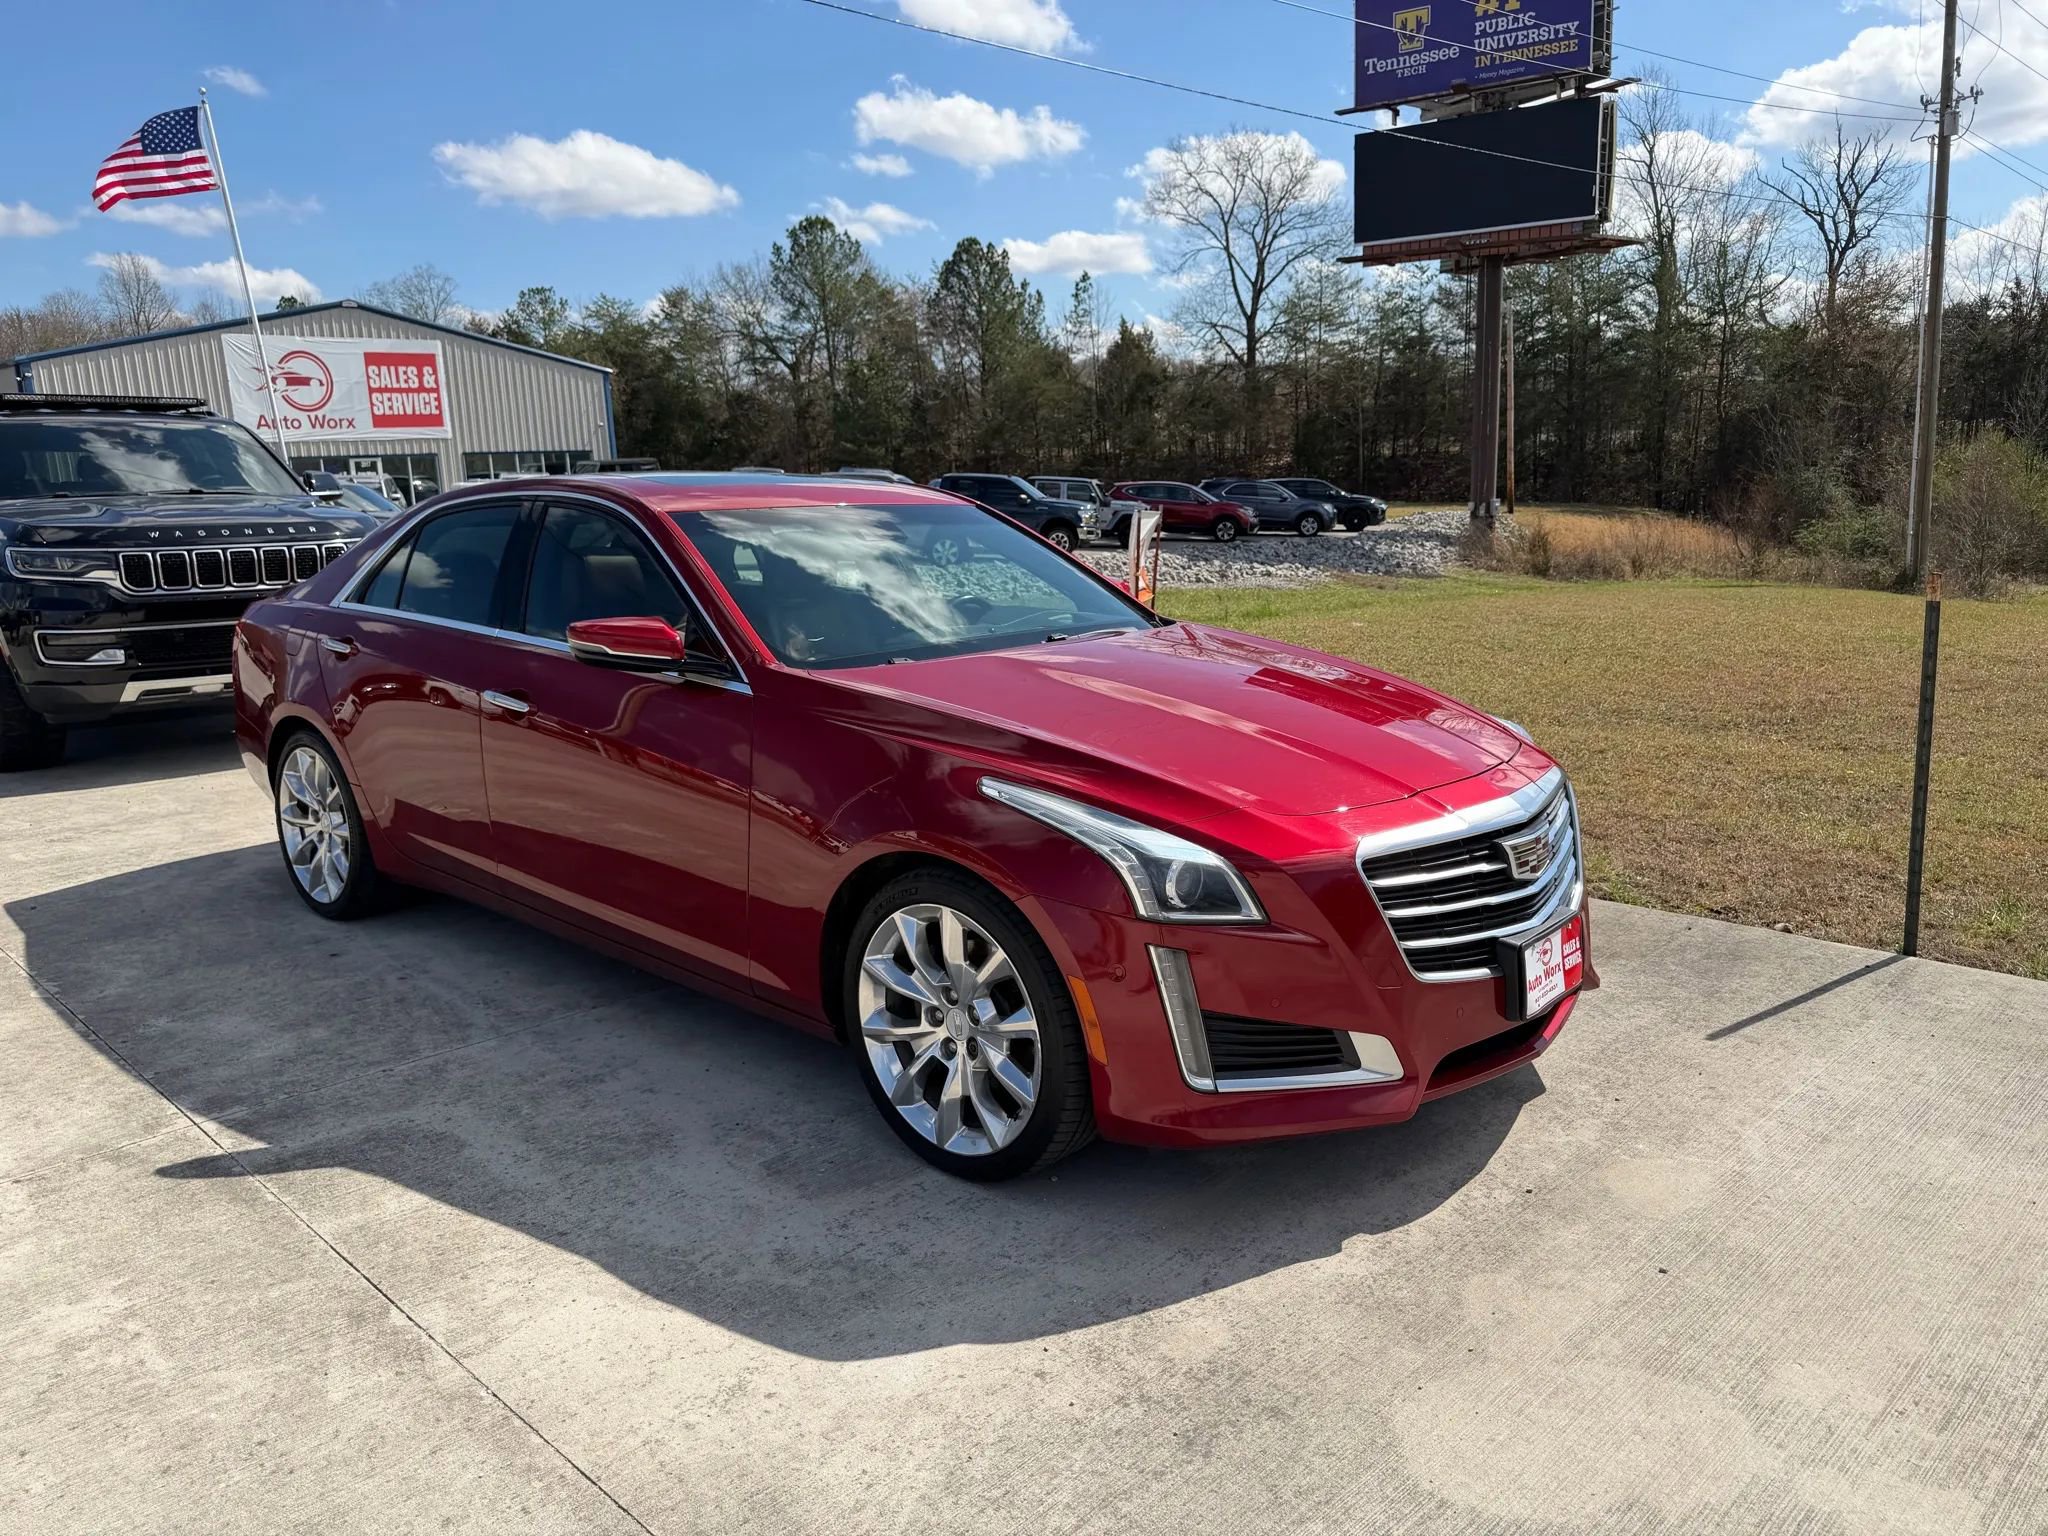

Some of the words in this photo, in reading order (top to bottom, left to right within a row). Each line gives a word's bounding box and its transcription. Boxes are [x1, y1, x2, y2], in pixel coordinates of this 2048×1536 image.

[1474, 11, 1536, 36] PUBLIC
[1474, 20, 1580, 52] UNIVERSITY
[1364, 46, 1460, 75] Tennessee
[1474, 54, 1491, 68] IN
[1492, 39, 1579, 65] TENNESSEE
[1396, 65, 1427, 78] TECH
[367, 365, 419, 389] SALES
[422, 366, 437, 389] &
[372, 392, 440, 416] SERVICE
[307, 414, 356, 430] Worx
[148, 525, 317, 538] WAGONEER
[1528, 975, 1543, 994] Auto
[1543, 961, 1562, 981] Worx
